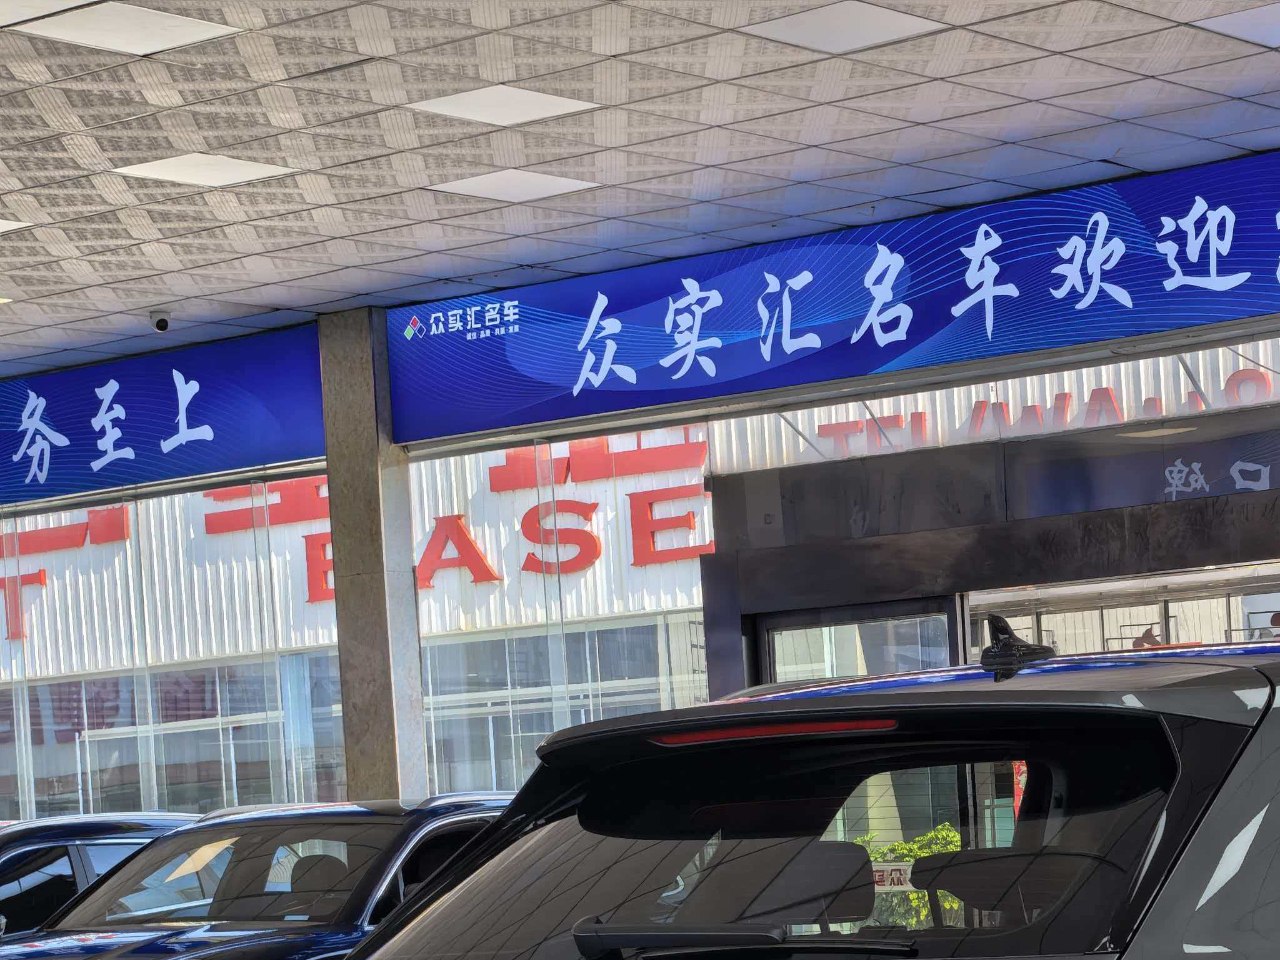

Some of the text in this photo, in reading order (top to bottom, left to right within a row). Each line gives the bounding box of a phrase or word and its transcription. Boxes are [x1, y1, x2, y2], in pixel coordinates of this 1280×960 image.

[429, 300, 519, 335] 众实汇名车
[12, 367, 215, 485] 务至上
